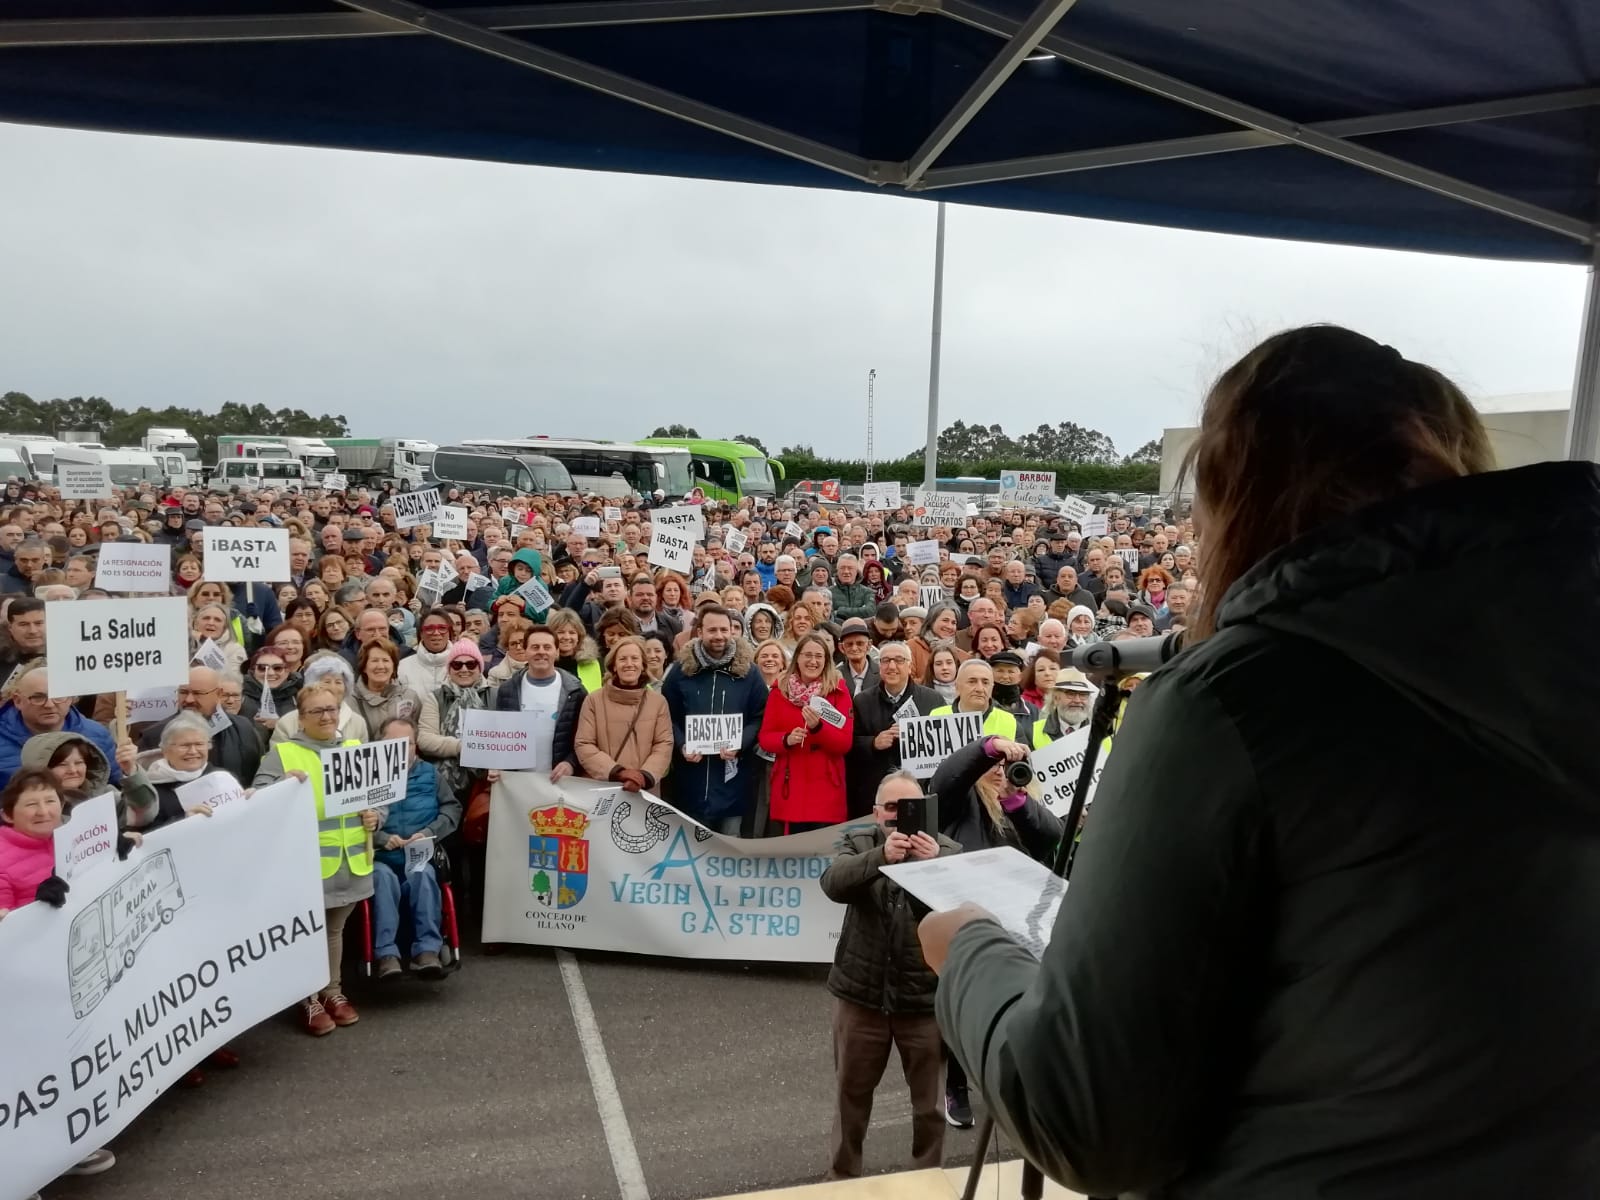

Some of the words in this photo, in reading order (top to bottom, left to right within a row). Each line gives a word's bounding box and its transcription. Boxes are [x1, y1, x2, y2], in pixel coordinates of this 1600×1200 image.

[1019, 472, 1052, 482] BARBÓN
[393, 494, 425, 518] ¡BASTA
[423, 490, 440, 512] YA!
[446, 511, 455, 521] No
[919, 515, 963, 526] CONTRATOS
[211, 539, 277, 552] ¡BASTA
[656, 532, 689, 551] ¡BASTA
[231, 556, 260, 568] YA!
[663, 548, 678, 561] YA!
[123, 568, 162, 577] SOLUCIÓN
[80, 620, 102, 641] La
[108, 616, 156, 640] Salud
[75, 653, 97, 671] no
[103, 648, 162, 672] espera
[475, 729, 527, 739] RESIGNACIÓN
[687, 717, 723, 741] ¡BASTA
[725, 716, 741, 739] YA!
[466, 742, 476, 750] NO
[486, 742, 527, 752] SOLUCIÓN
[901, 718, 954, 760] ¡BASTA
[323, 746, 381, 796] ¡BASTA
[384, 741, 407, 783] YA!
[125, 879, 157, 917] RURAL
[738, 884, 803, 908] PICO
[525, 910, 572, 922] CONCEJO
[574, 914, 588, 923] DE
[537, 920, 575, 931] ILLANO
[681, 911, 801, 937] CASTRO
[70, 1033, 123, 1092] DEL
[124, 959, 220, 1047] MUNDO
[226, 909, 324, 974] RURAL
[66, 1090, 110, 1145] DE
[116, 995, 234, 1108] ASTURIAS
